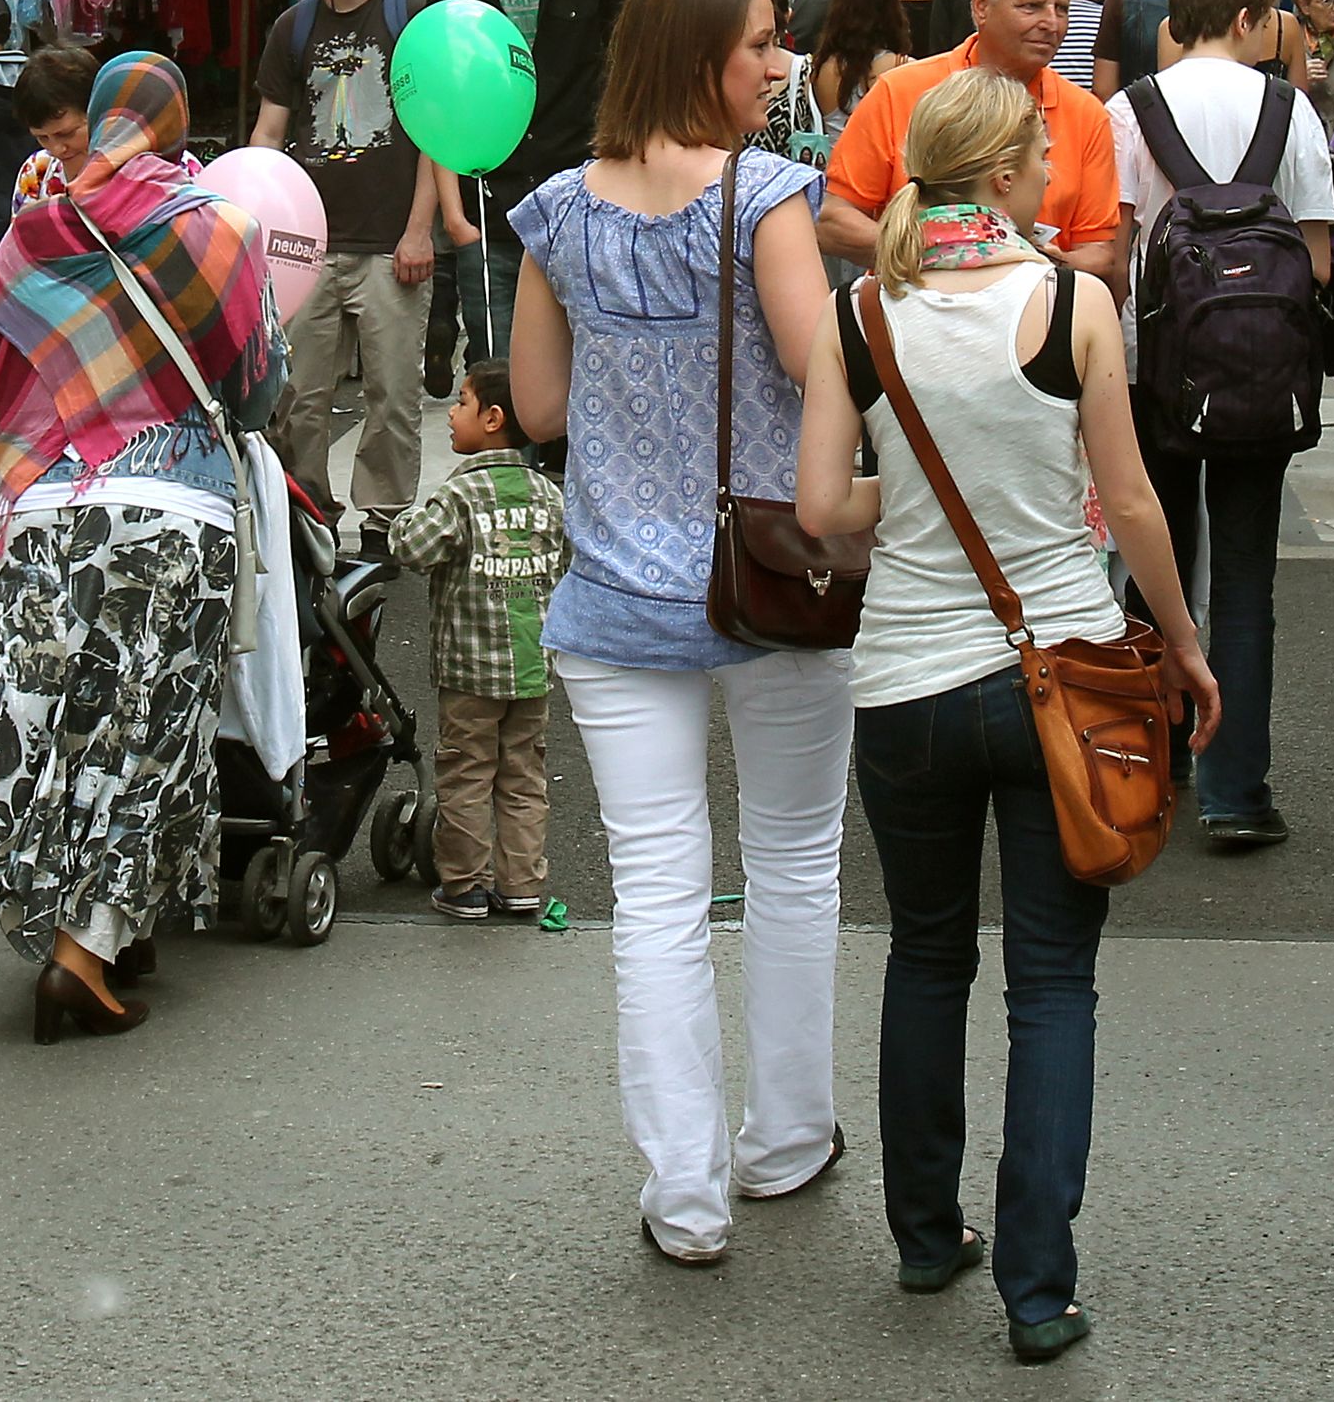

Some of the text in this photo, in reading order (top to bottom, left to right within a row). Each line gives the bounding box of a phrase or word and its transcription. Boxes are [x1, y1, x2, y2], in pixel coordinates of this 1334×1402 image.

[271, 238, 325, 262] neubaug
[475, 507, 548, 534] BEN'S
[470, 551, 560, 578] COMPANY
